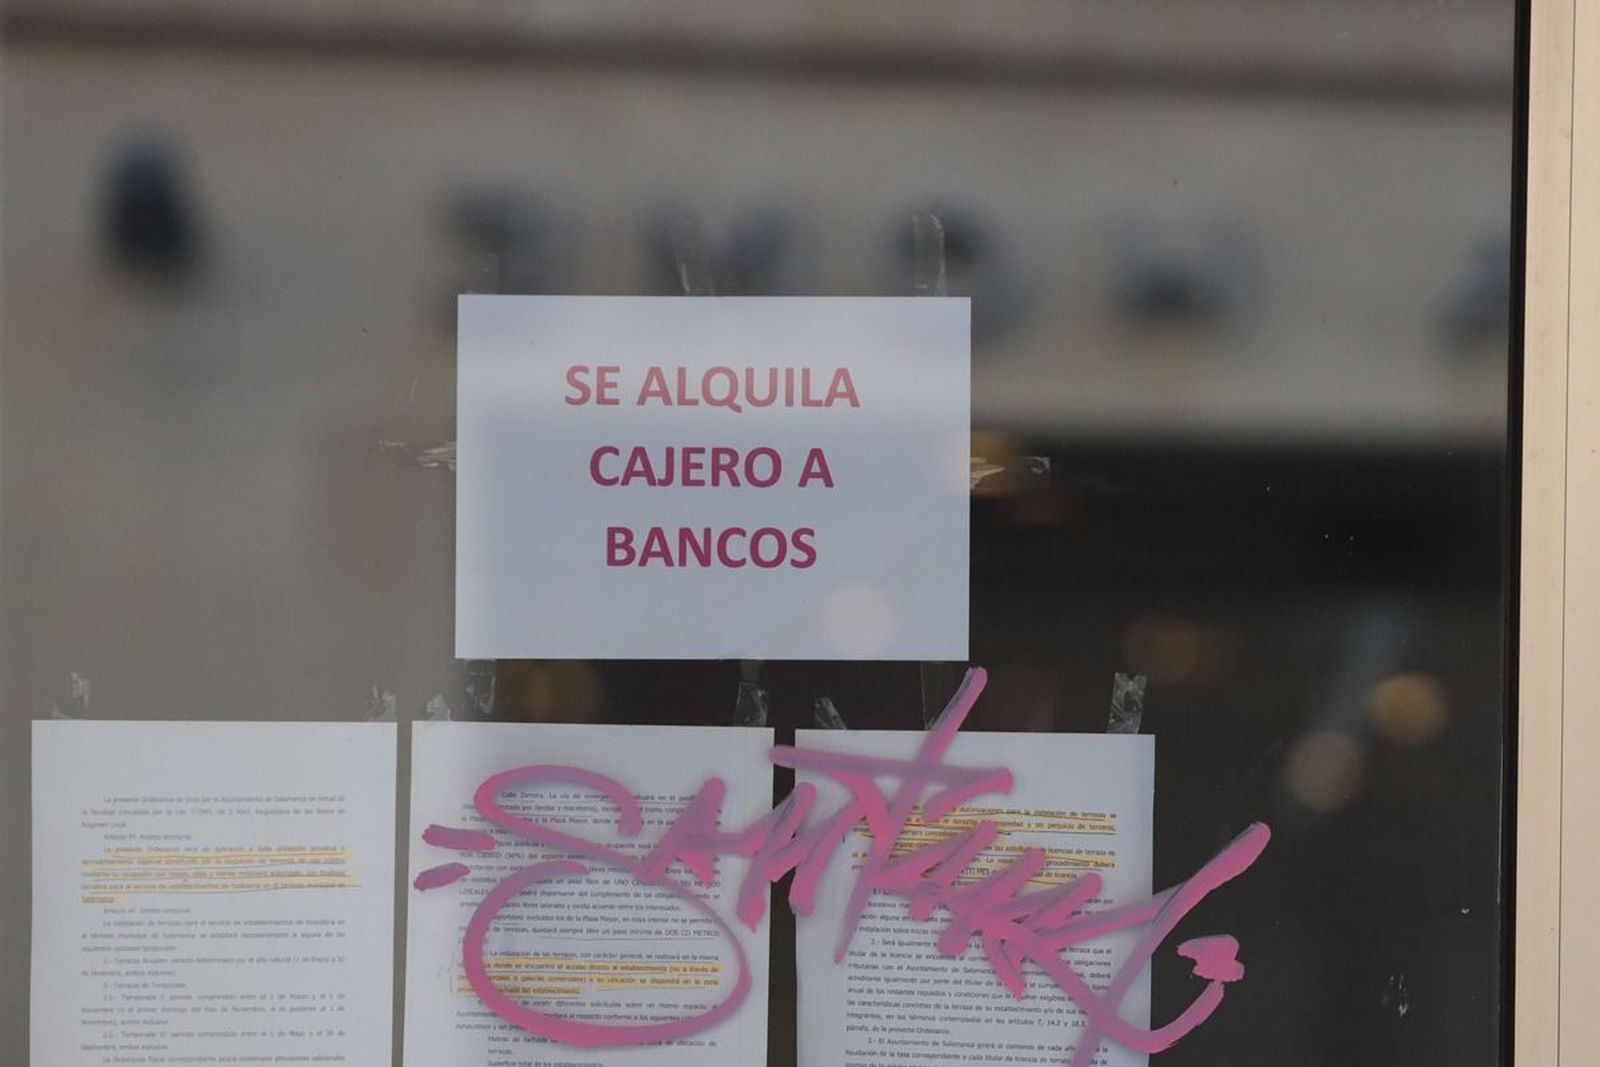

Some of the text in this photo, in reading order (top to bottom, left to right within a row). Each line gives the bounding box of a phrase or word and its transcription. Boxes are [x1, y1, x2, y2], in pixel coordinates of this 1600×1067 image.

[564, 365, 860, 413] SE ALQUILA
[590, 446, 834, 488] CAJERO A
[606, 526, 817, 569] BANCOS
